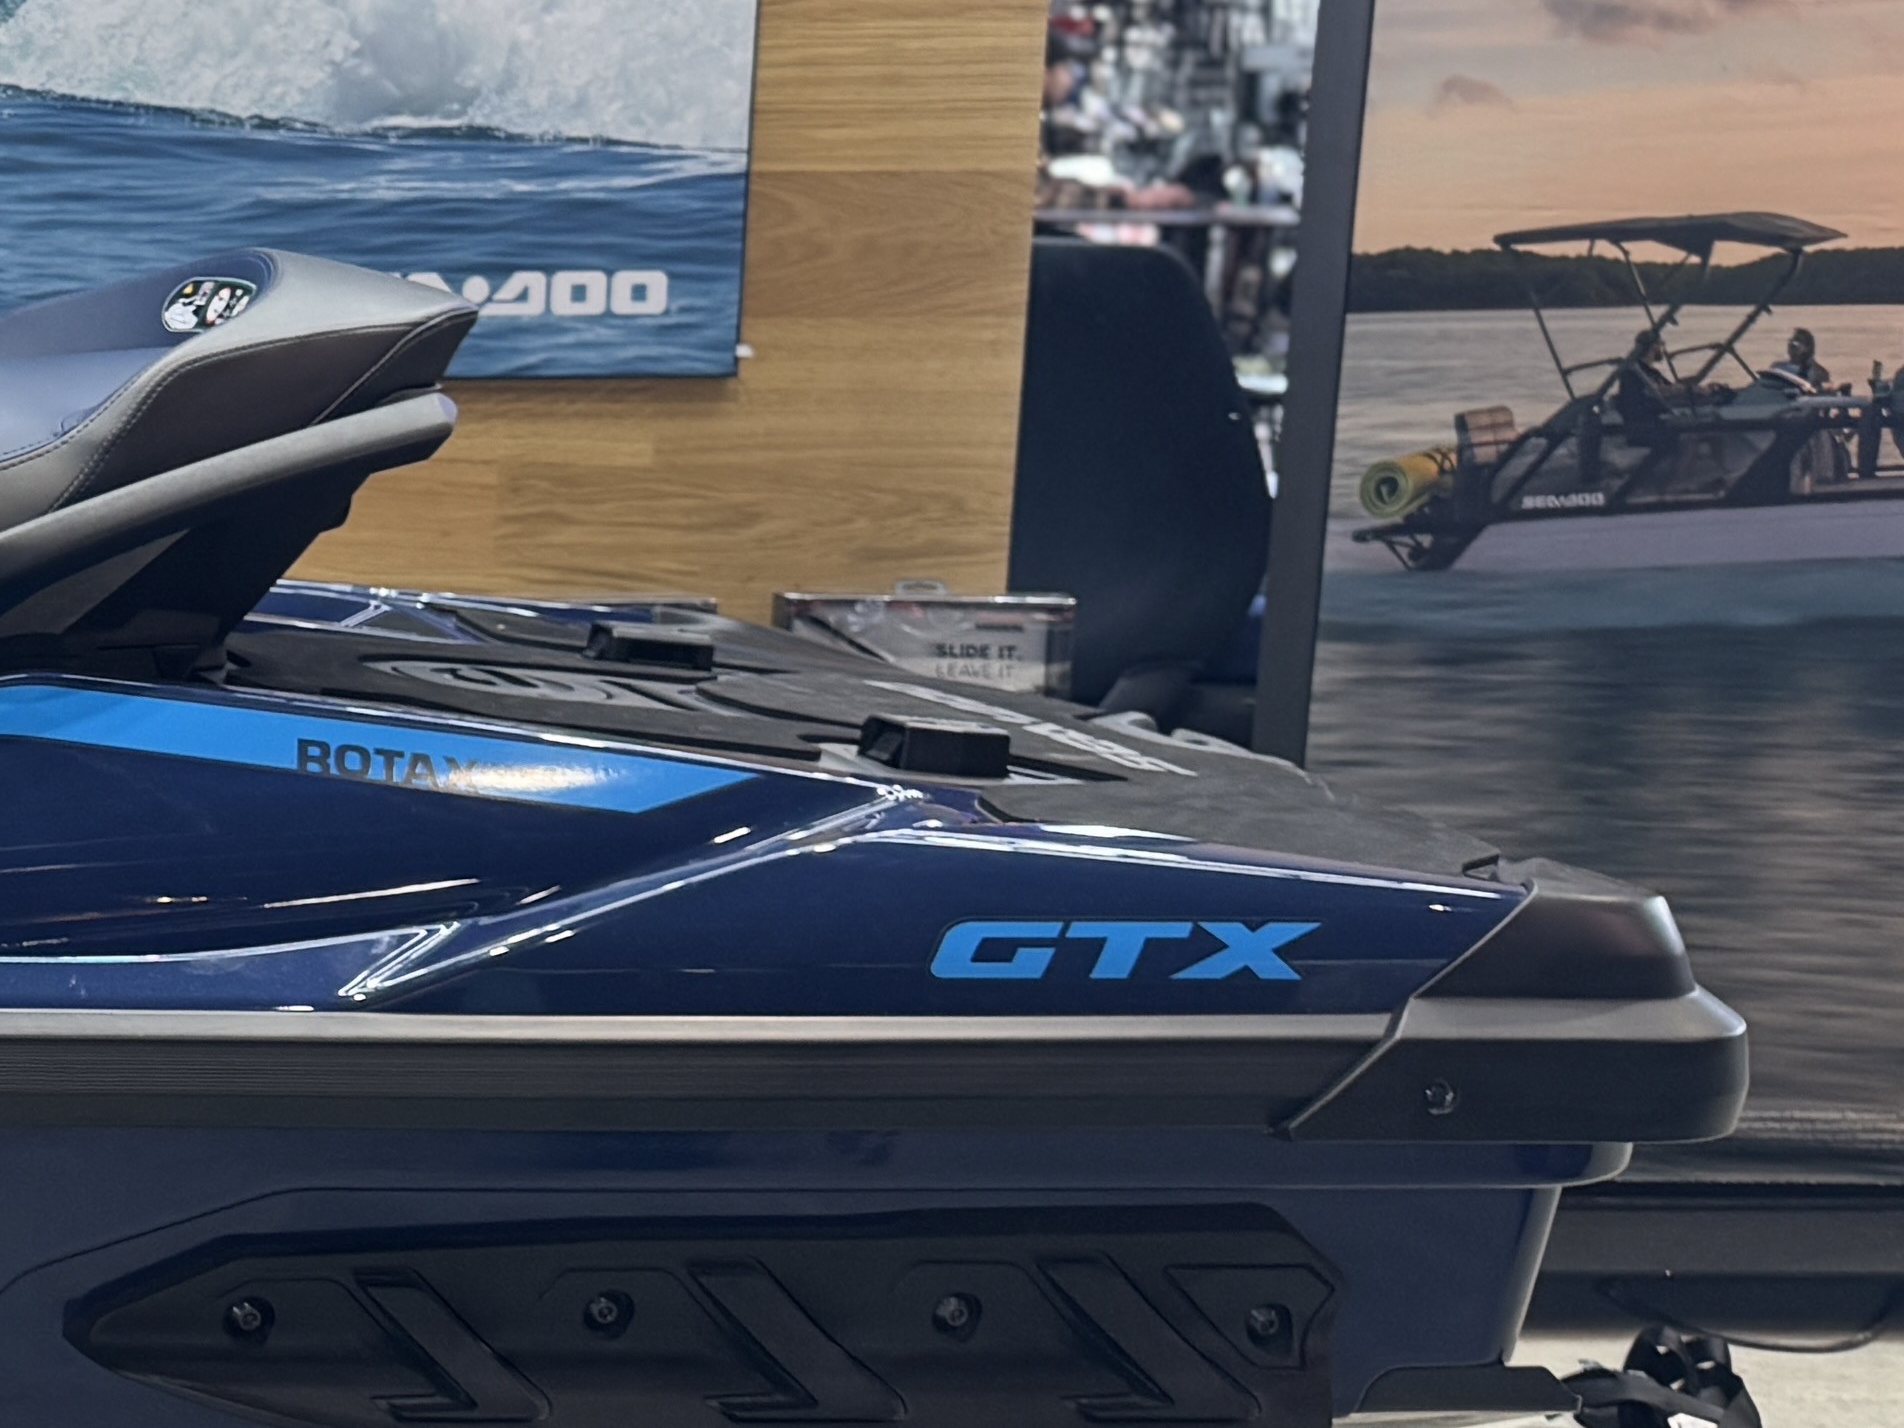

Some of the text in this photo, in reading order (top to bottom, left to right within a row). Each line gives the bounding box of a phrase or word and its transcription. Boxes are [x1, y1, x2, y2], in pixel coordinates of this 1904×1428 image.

[935, 643, 990, 660] SLIDE
[296, 738, 480, 794] ROTAX
[931, 921, 1322, 980] GTX
